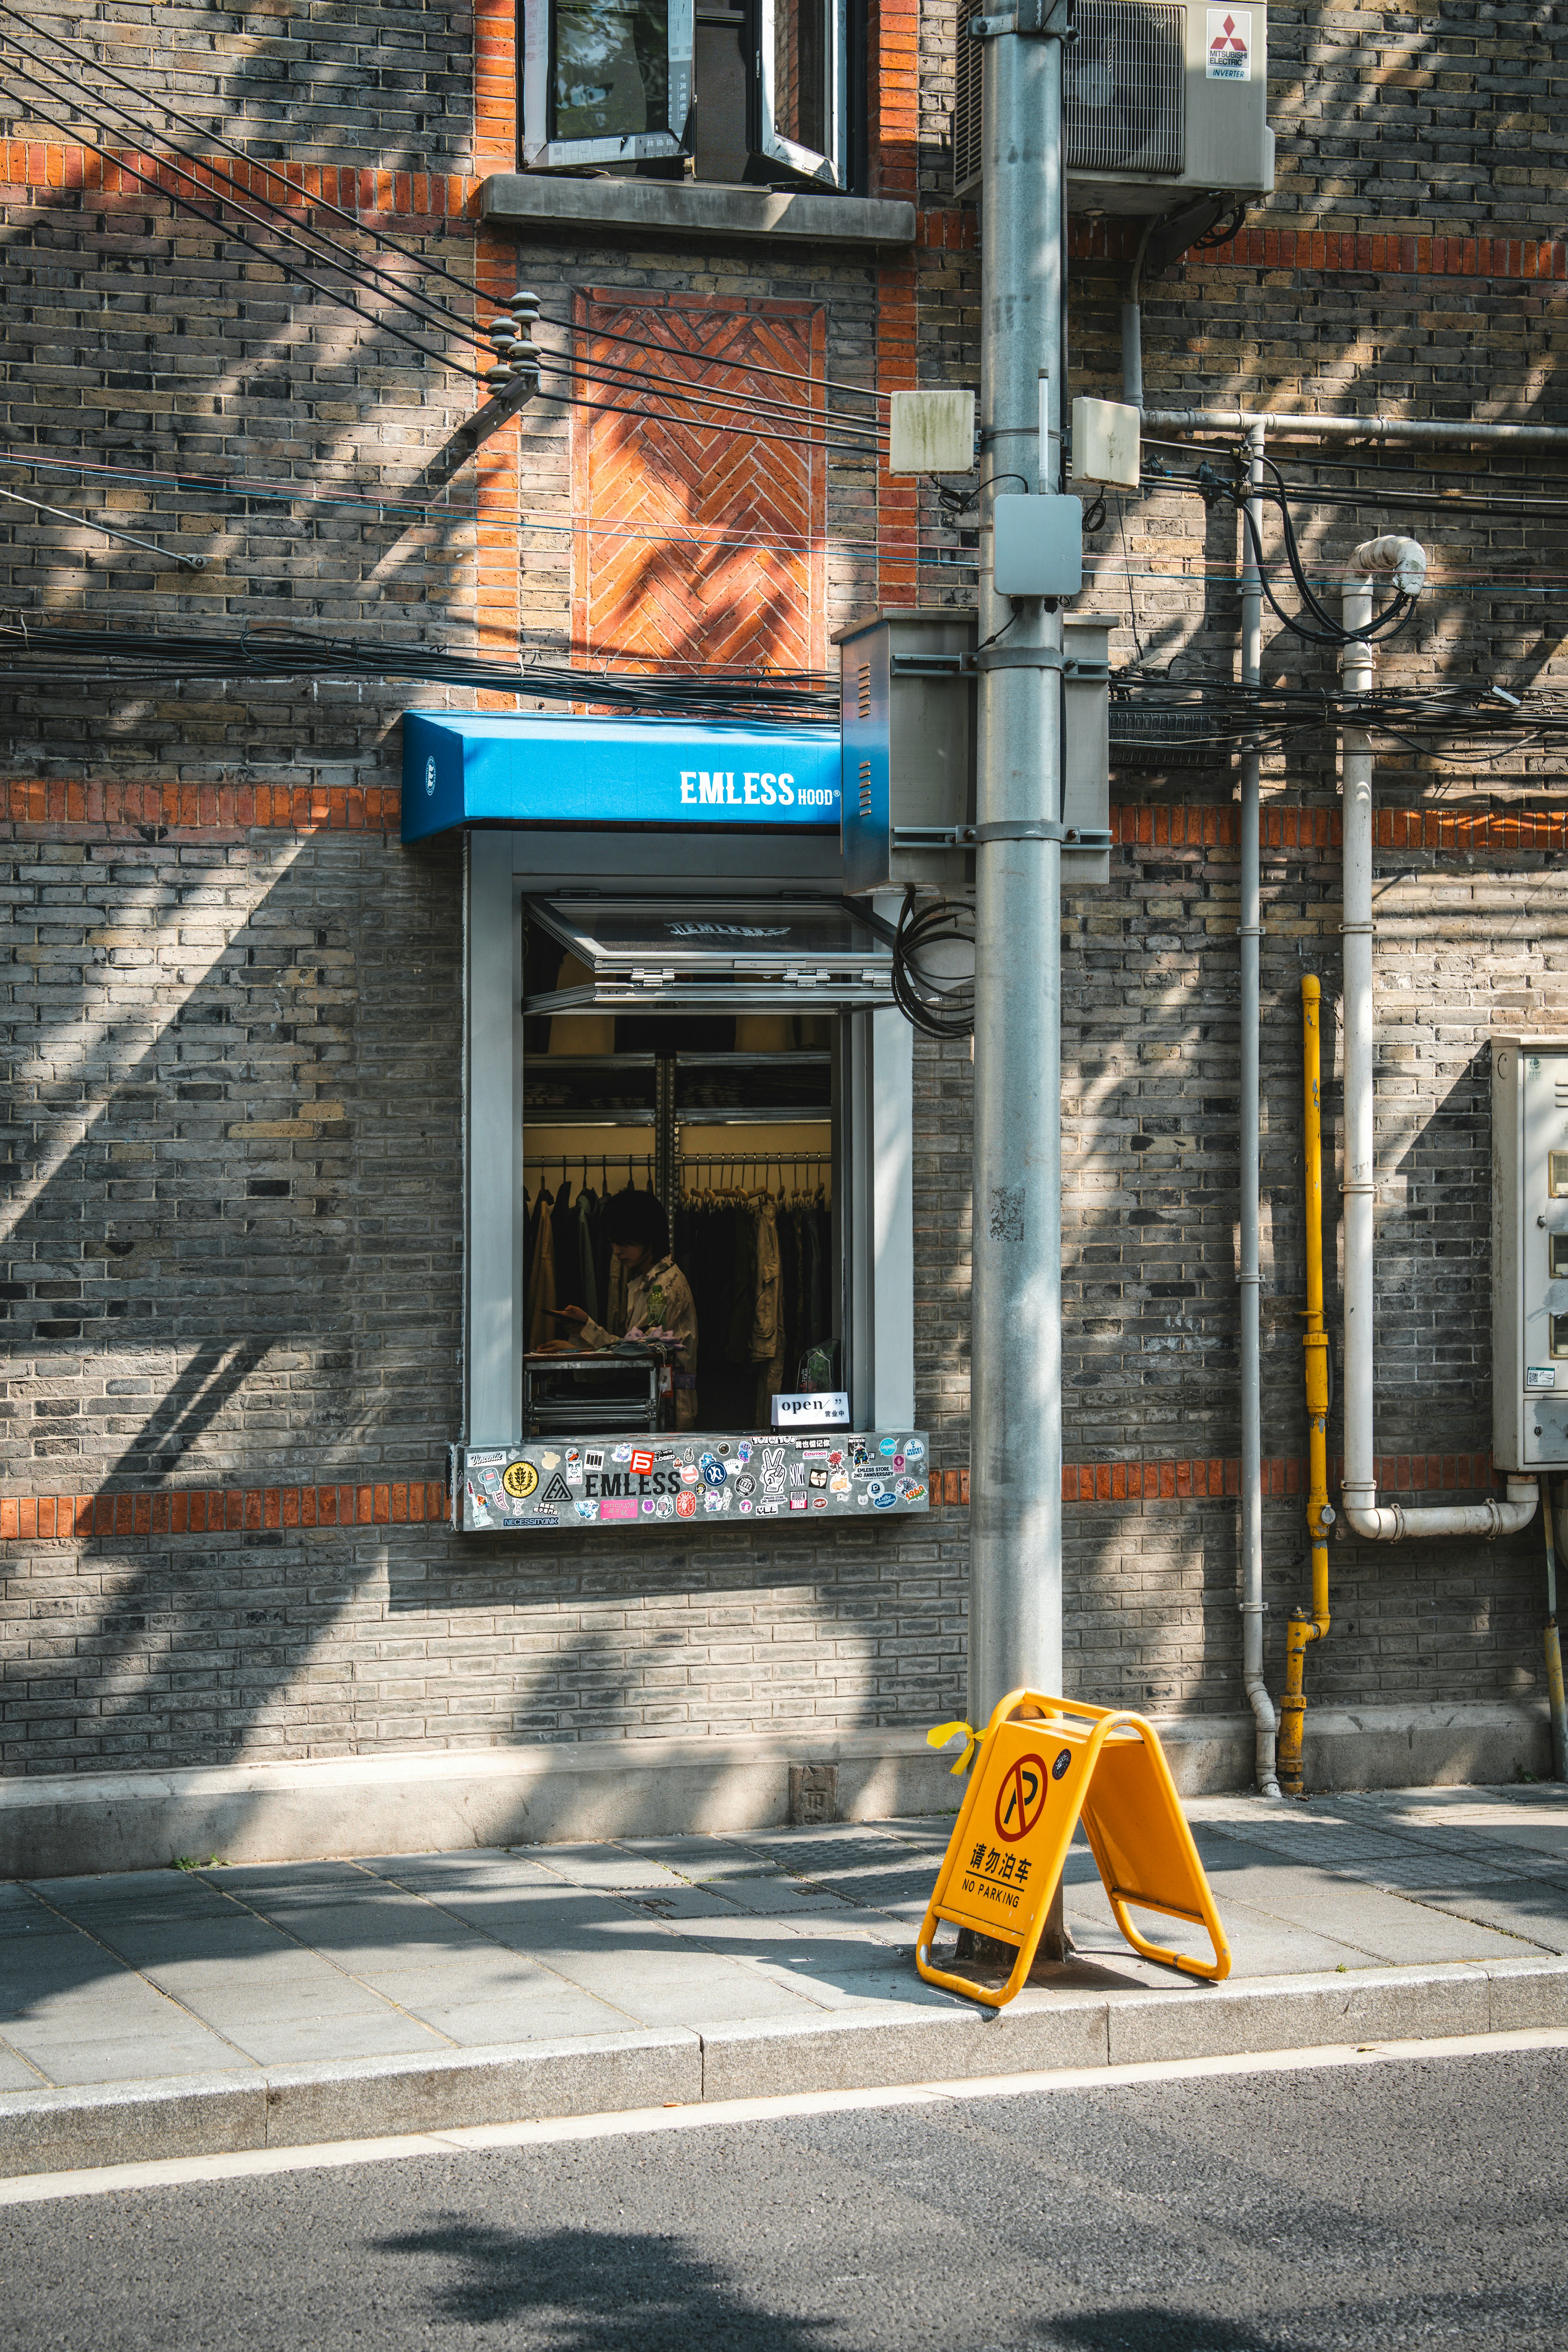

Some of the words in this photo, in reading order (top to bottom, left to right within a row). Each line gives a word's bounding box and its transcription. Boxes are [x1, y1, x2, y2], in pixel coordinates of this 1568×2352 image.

[1210, 50, 1247, 59] MITSUBISHI
[1210, 58, 1242, 66] ELECTRIC
[1213, 69, 1245, 78] INVERTER
[647, 138, 673, 147] 铝铝材
[679, 771, 795, 806] EMLESS
[684, 923, 764, 933] EMLESS
[782, 1400, 822, 1414] open
[795, 1439, 830, 1449] 我也惦记你
[789, 1463, 805, 1487] SORT
[585, 1472, 681, 1497] EMLESS
[515, 1484, 535, 1497] SKATESHOP
[792, 1491, 806, 1500] HIDDEN
[906, 1485, 924, 1500] 1960
[792, 1500, 806, 1509] TRACK
[504, 1517, 559, 1526] NECESSITY.INK
[970, 1843, 1032, 1884] 请勿泊车
[962, 1878, 975, 1892] NO
[978, 1884, 1020, 1908] PARKING
